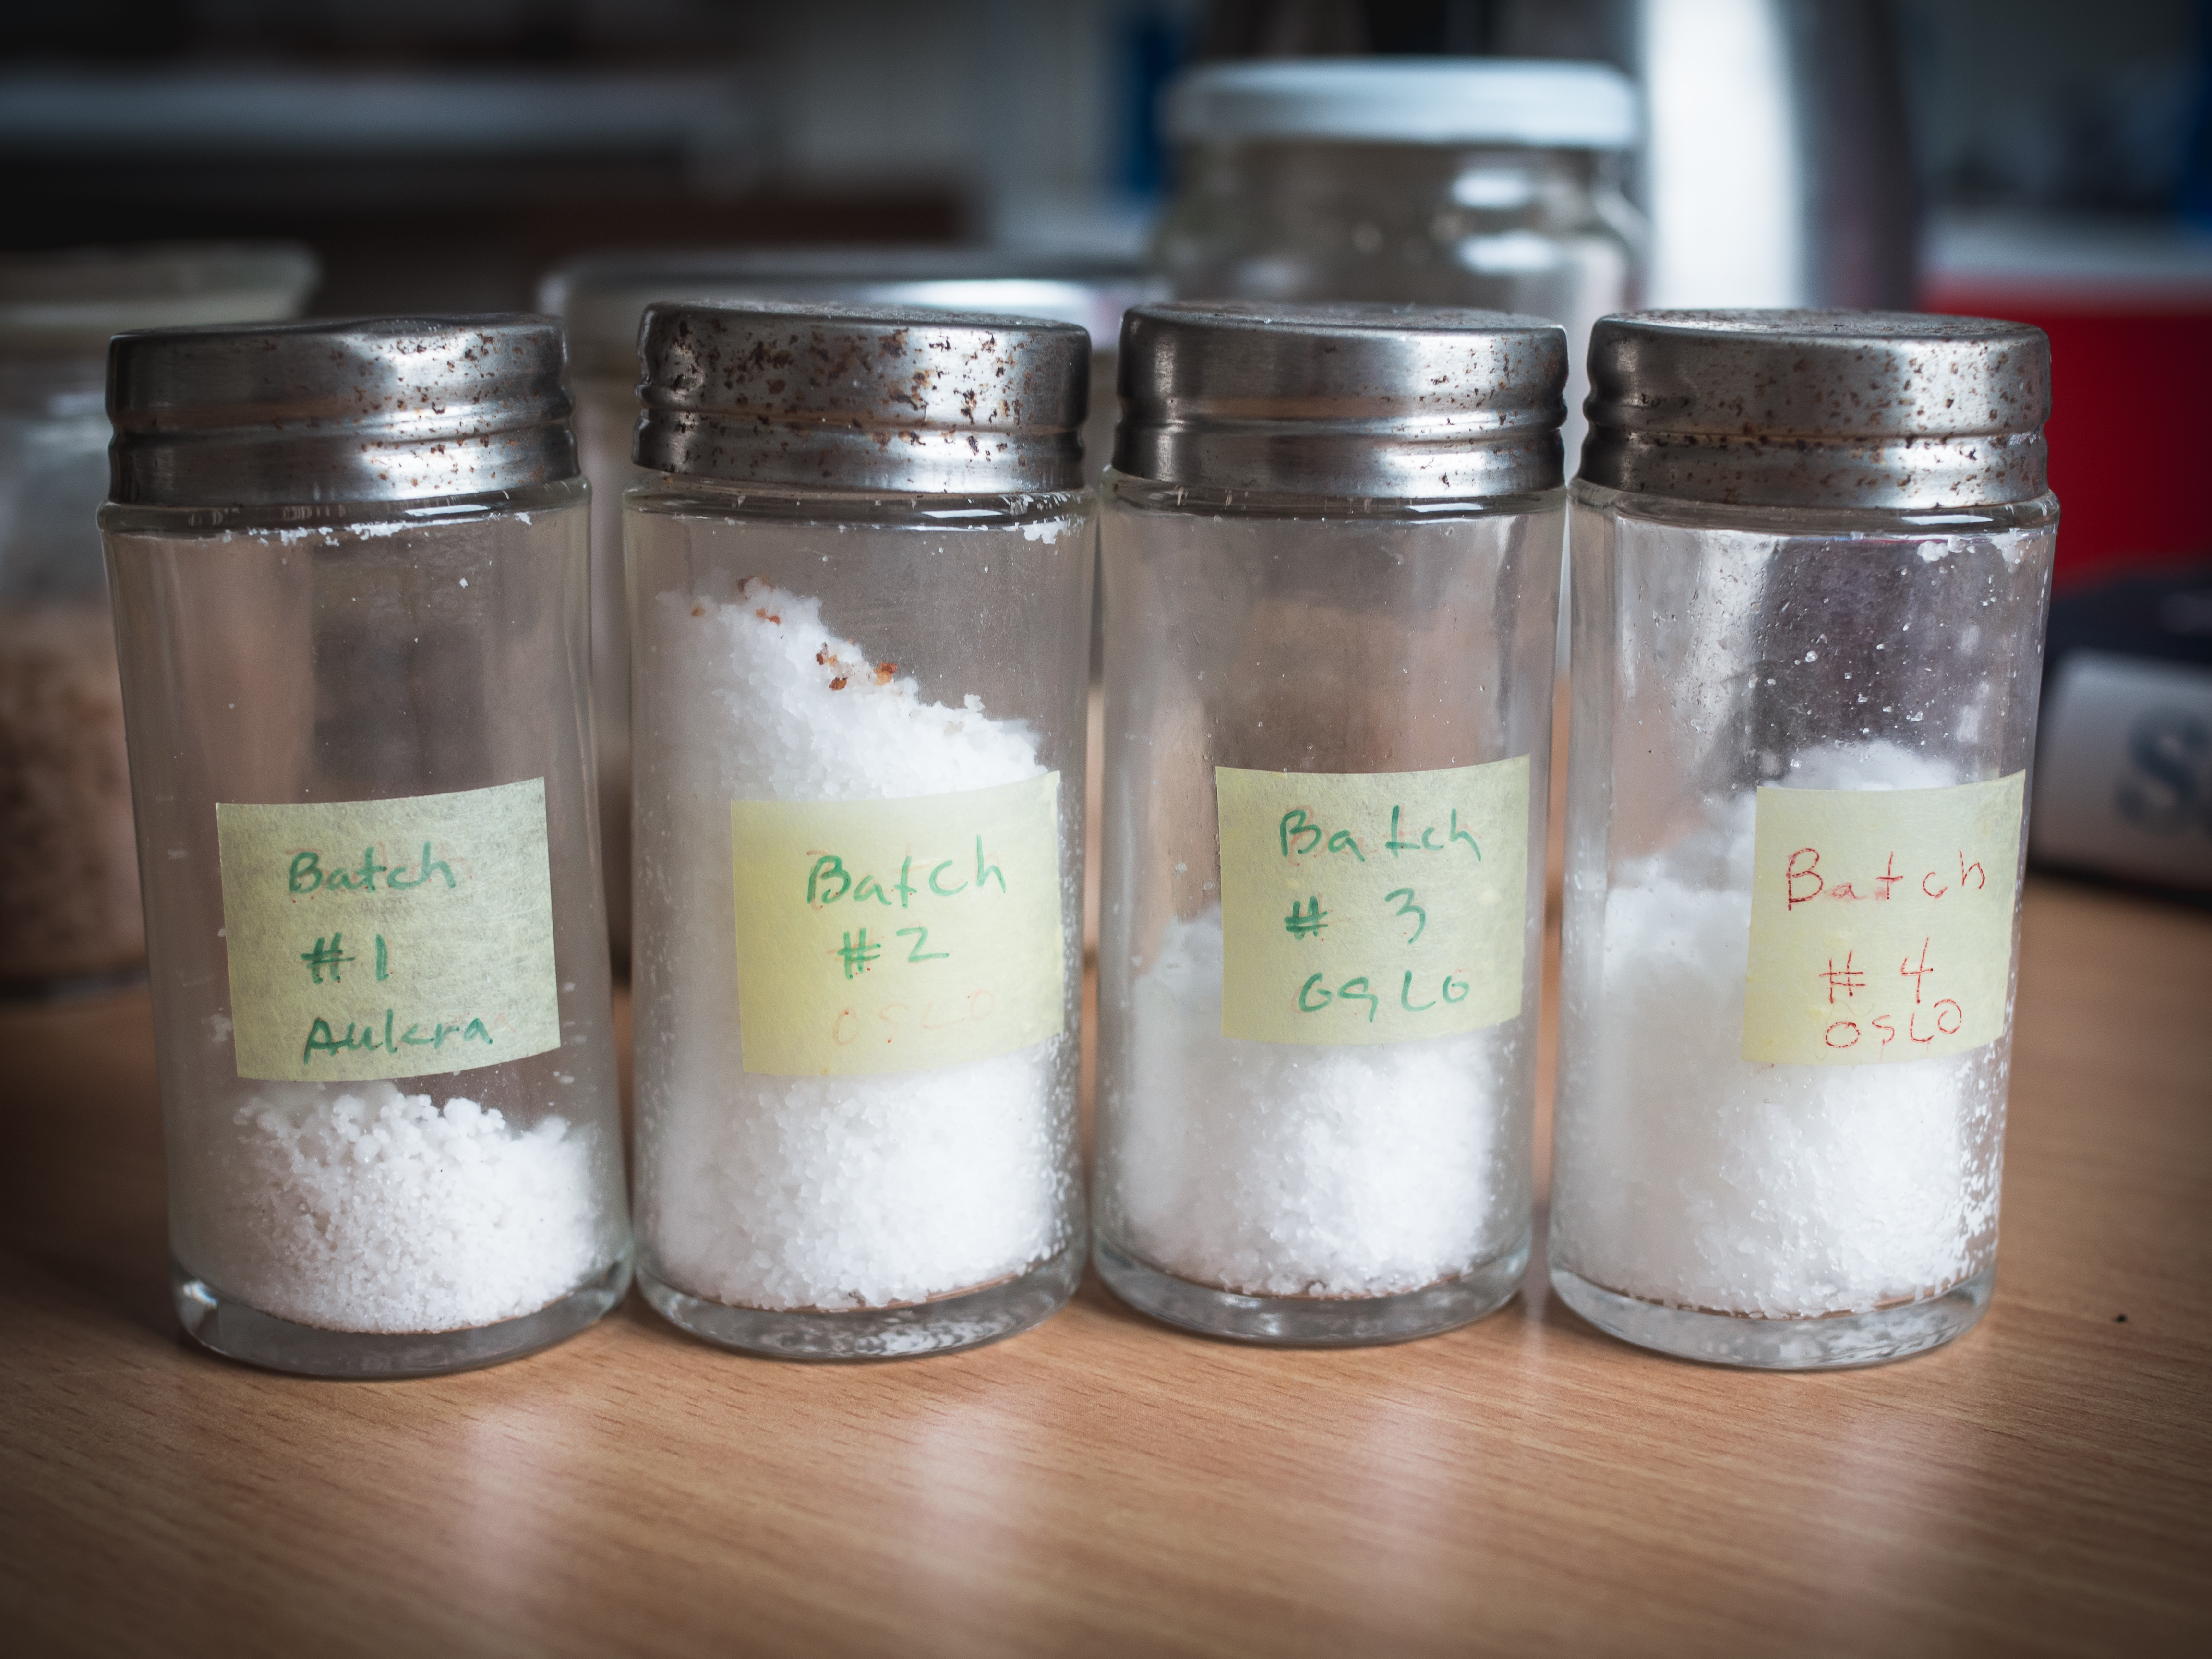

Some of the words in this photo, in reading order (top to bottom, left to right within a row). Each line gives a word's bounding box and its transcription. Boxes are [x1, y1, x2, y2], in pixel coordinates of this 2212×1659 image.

[1280, 805, 1481, 862] Batch
[289, 841, 457, 894] Batch
[807, 834, 1007, 908] Batch
[1786, 847, 1986, 911] Batch
[832, 989, 996, 1046] OSLO
[1825, 998, 1962, 1048] OSLO
